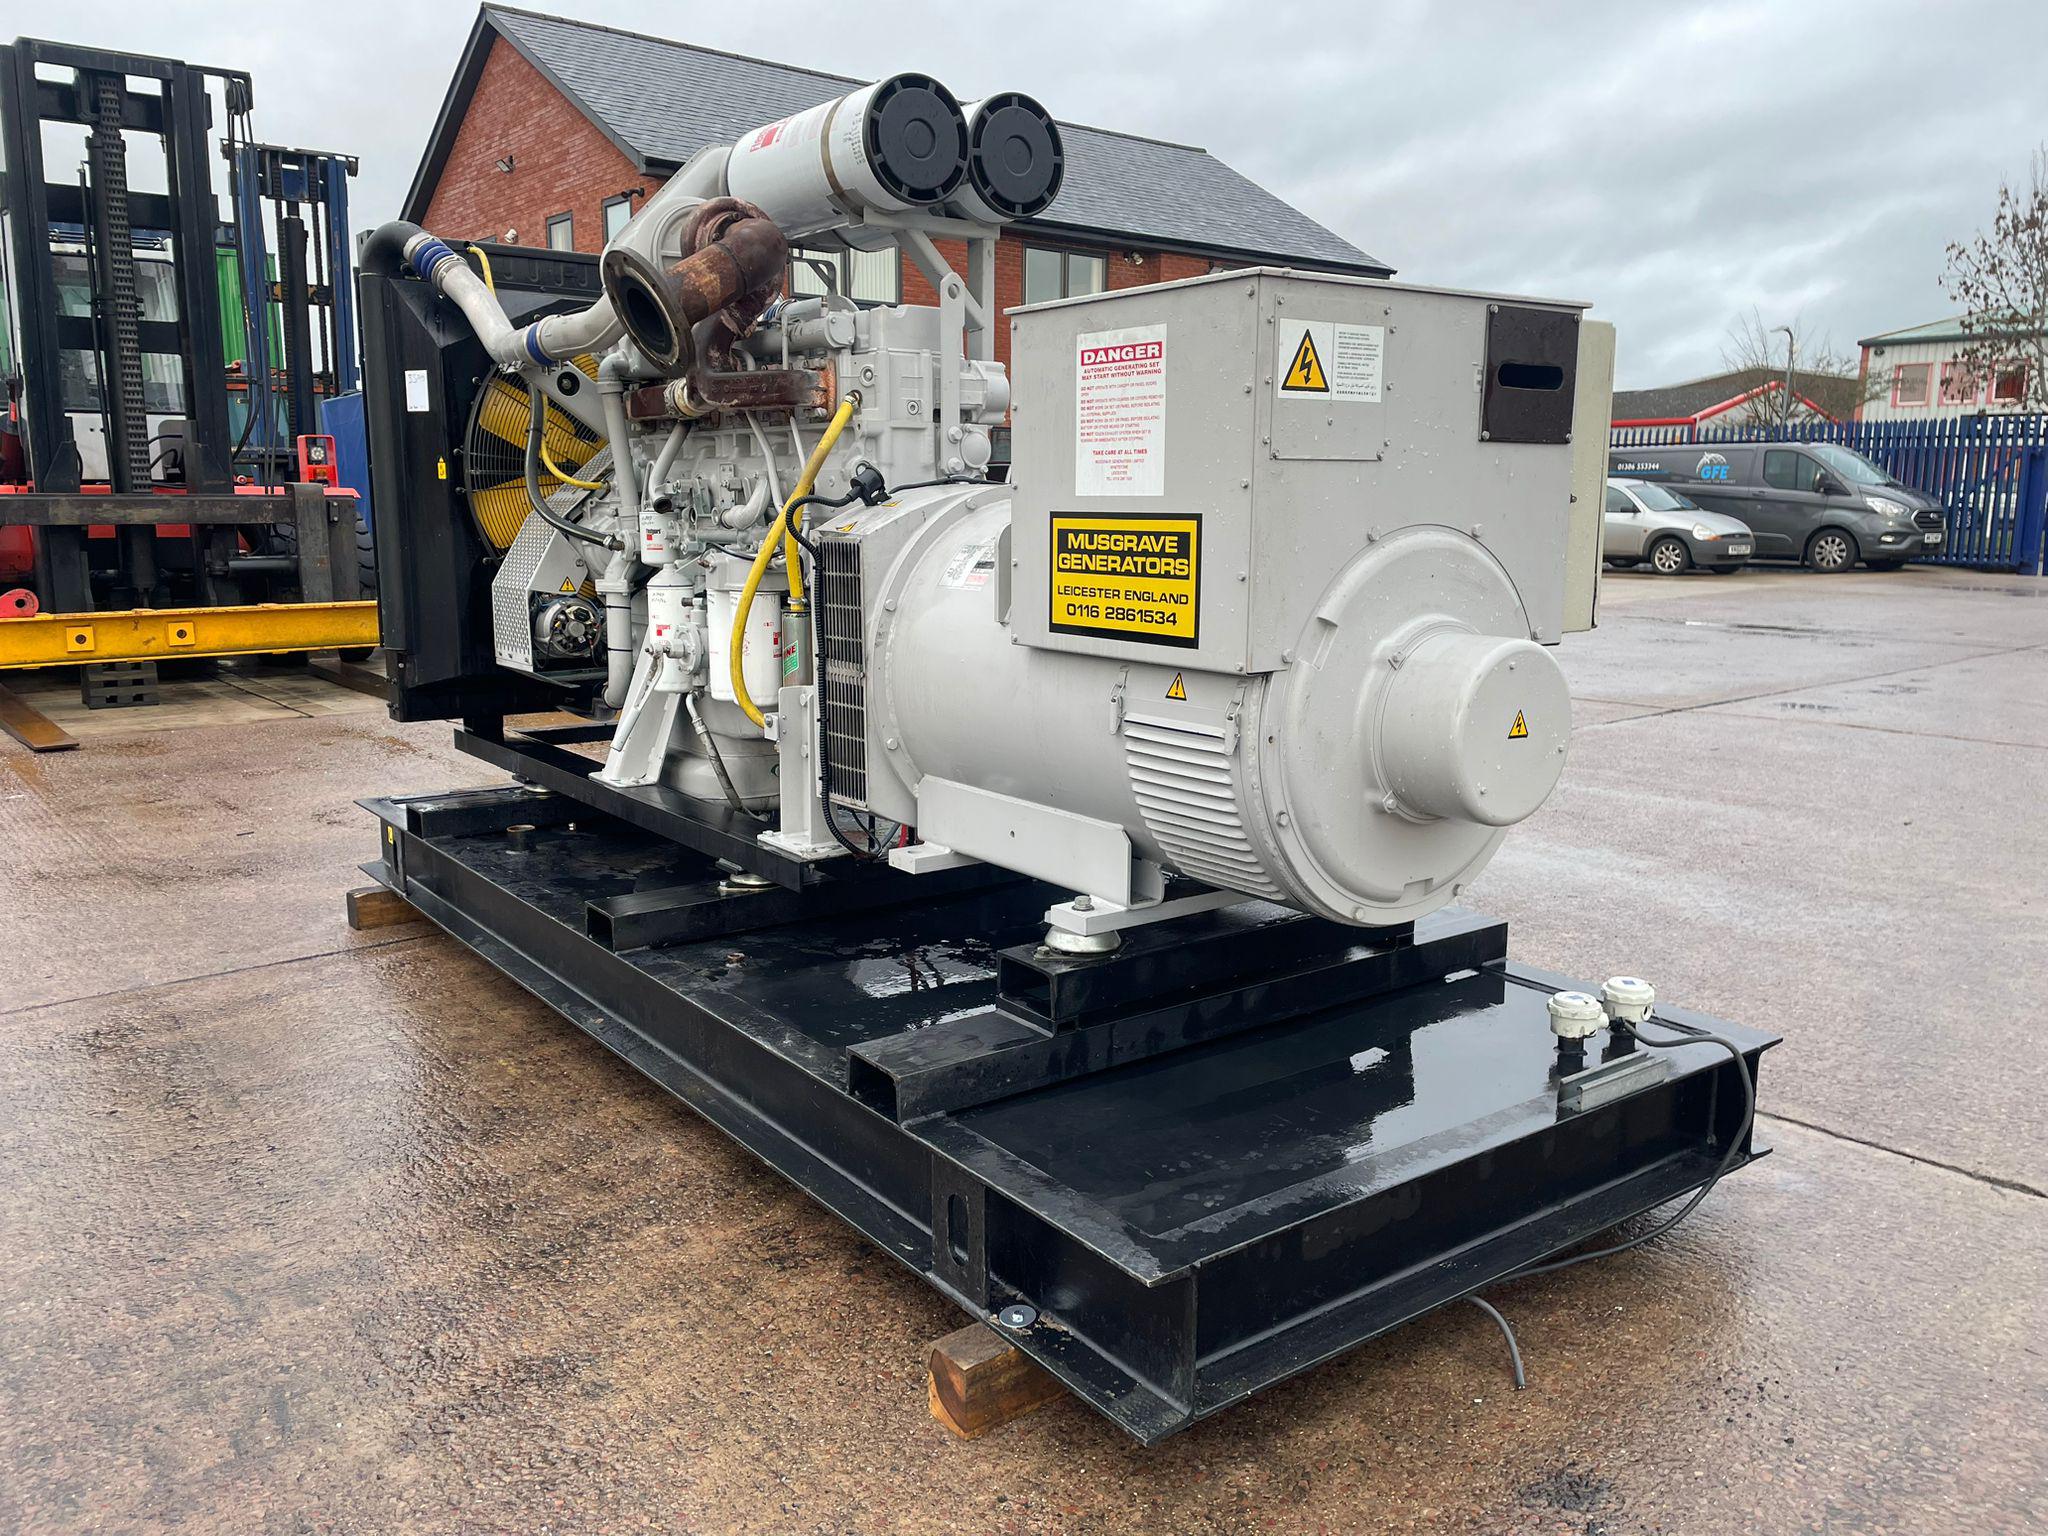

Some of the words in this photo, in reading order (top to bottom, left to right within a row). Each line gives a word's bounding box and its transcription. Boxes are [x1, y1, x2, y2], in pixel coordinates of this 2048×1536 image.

[1083, 345, 1160, 364] DANGER
[1084, 365, 1113, 374] AUTOMATIC
[1114, 362, 1148, 371] GENERATING
[1093, 372, 1110, 380] START
[1111, 370, 1135, 378] WITHOUT
[1136, 368, 1162, 376] WARNING
[1700, 465, 1730, 479] GFE
[1067, 533, 1178, 553] MUSGRAVE
[1058, 553, 1189, 576] GENERATORS
[1057, 585, 1121, 599] LEICESTER
[1124, 590, 1189, 605] ENGLAND
[1066, 603, 1100, 618] 0116
[1105, 606, 1177, 626] 2861534
